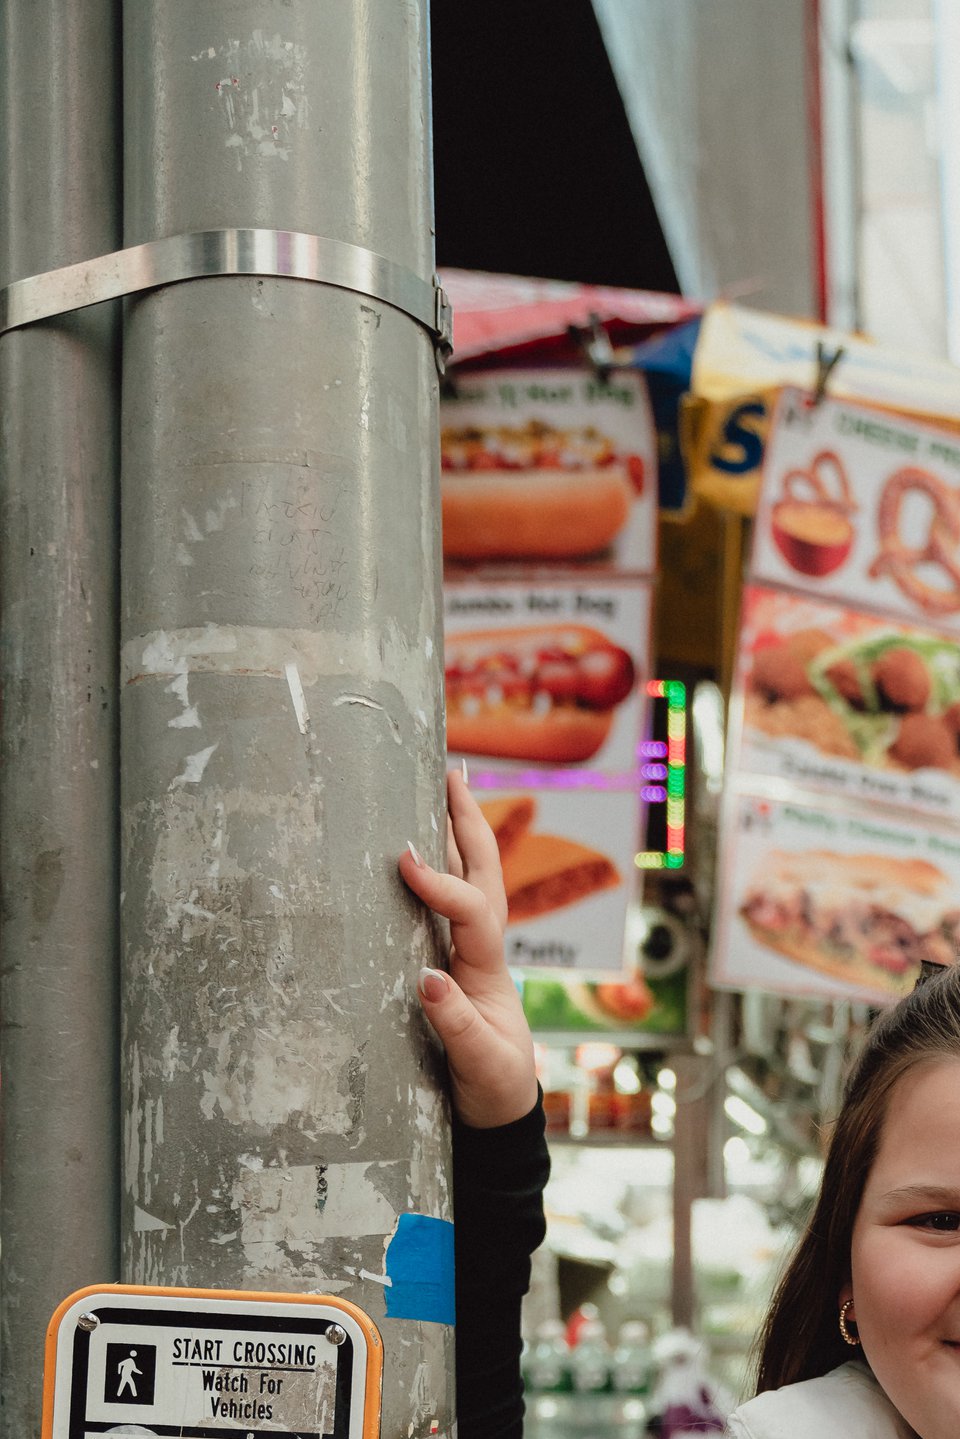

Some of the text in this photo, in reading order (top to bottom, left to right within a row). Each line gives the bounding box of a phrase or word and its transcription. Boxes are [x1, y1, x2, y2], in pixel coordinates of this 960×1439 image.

[173, 1338, 316, 1366] START CROSSING
[202, 1369, 283, 1395] Watch For
[210, 1396, 273, 1420] Vehicles
